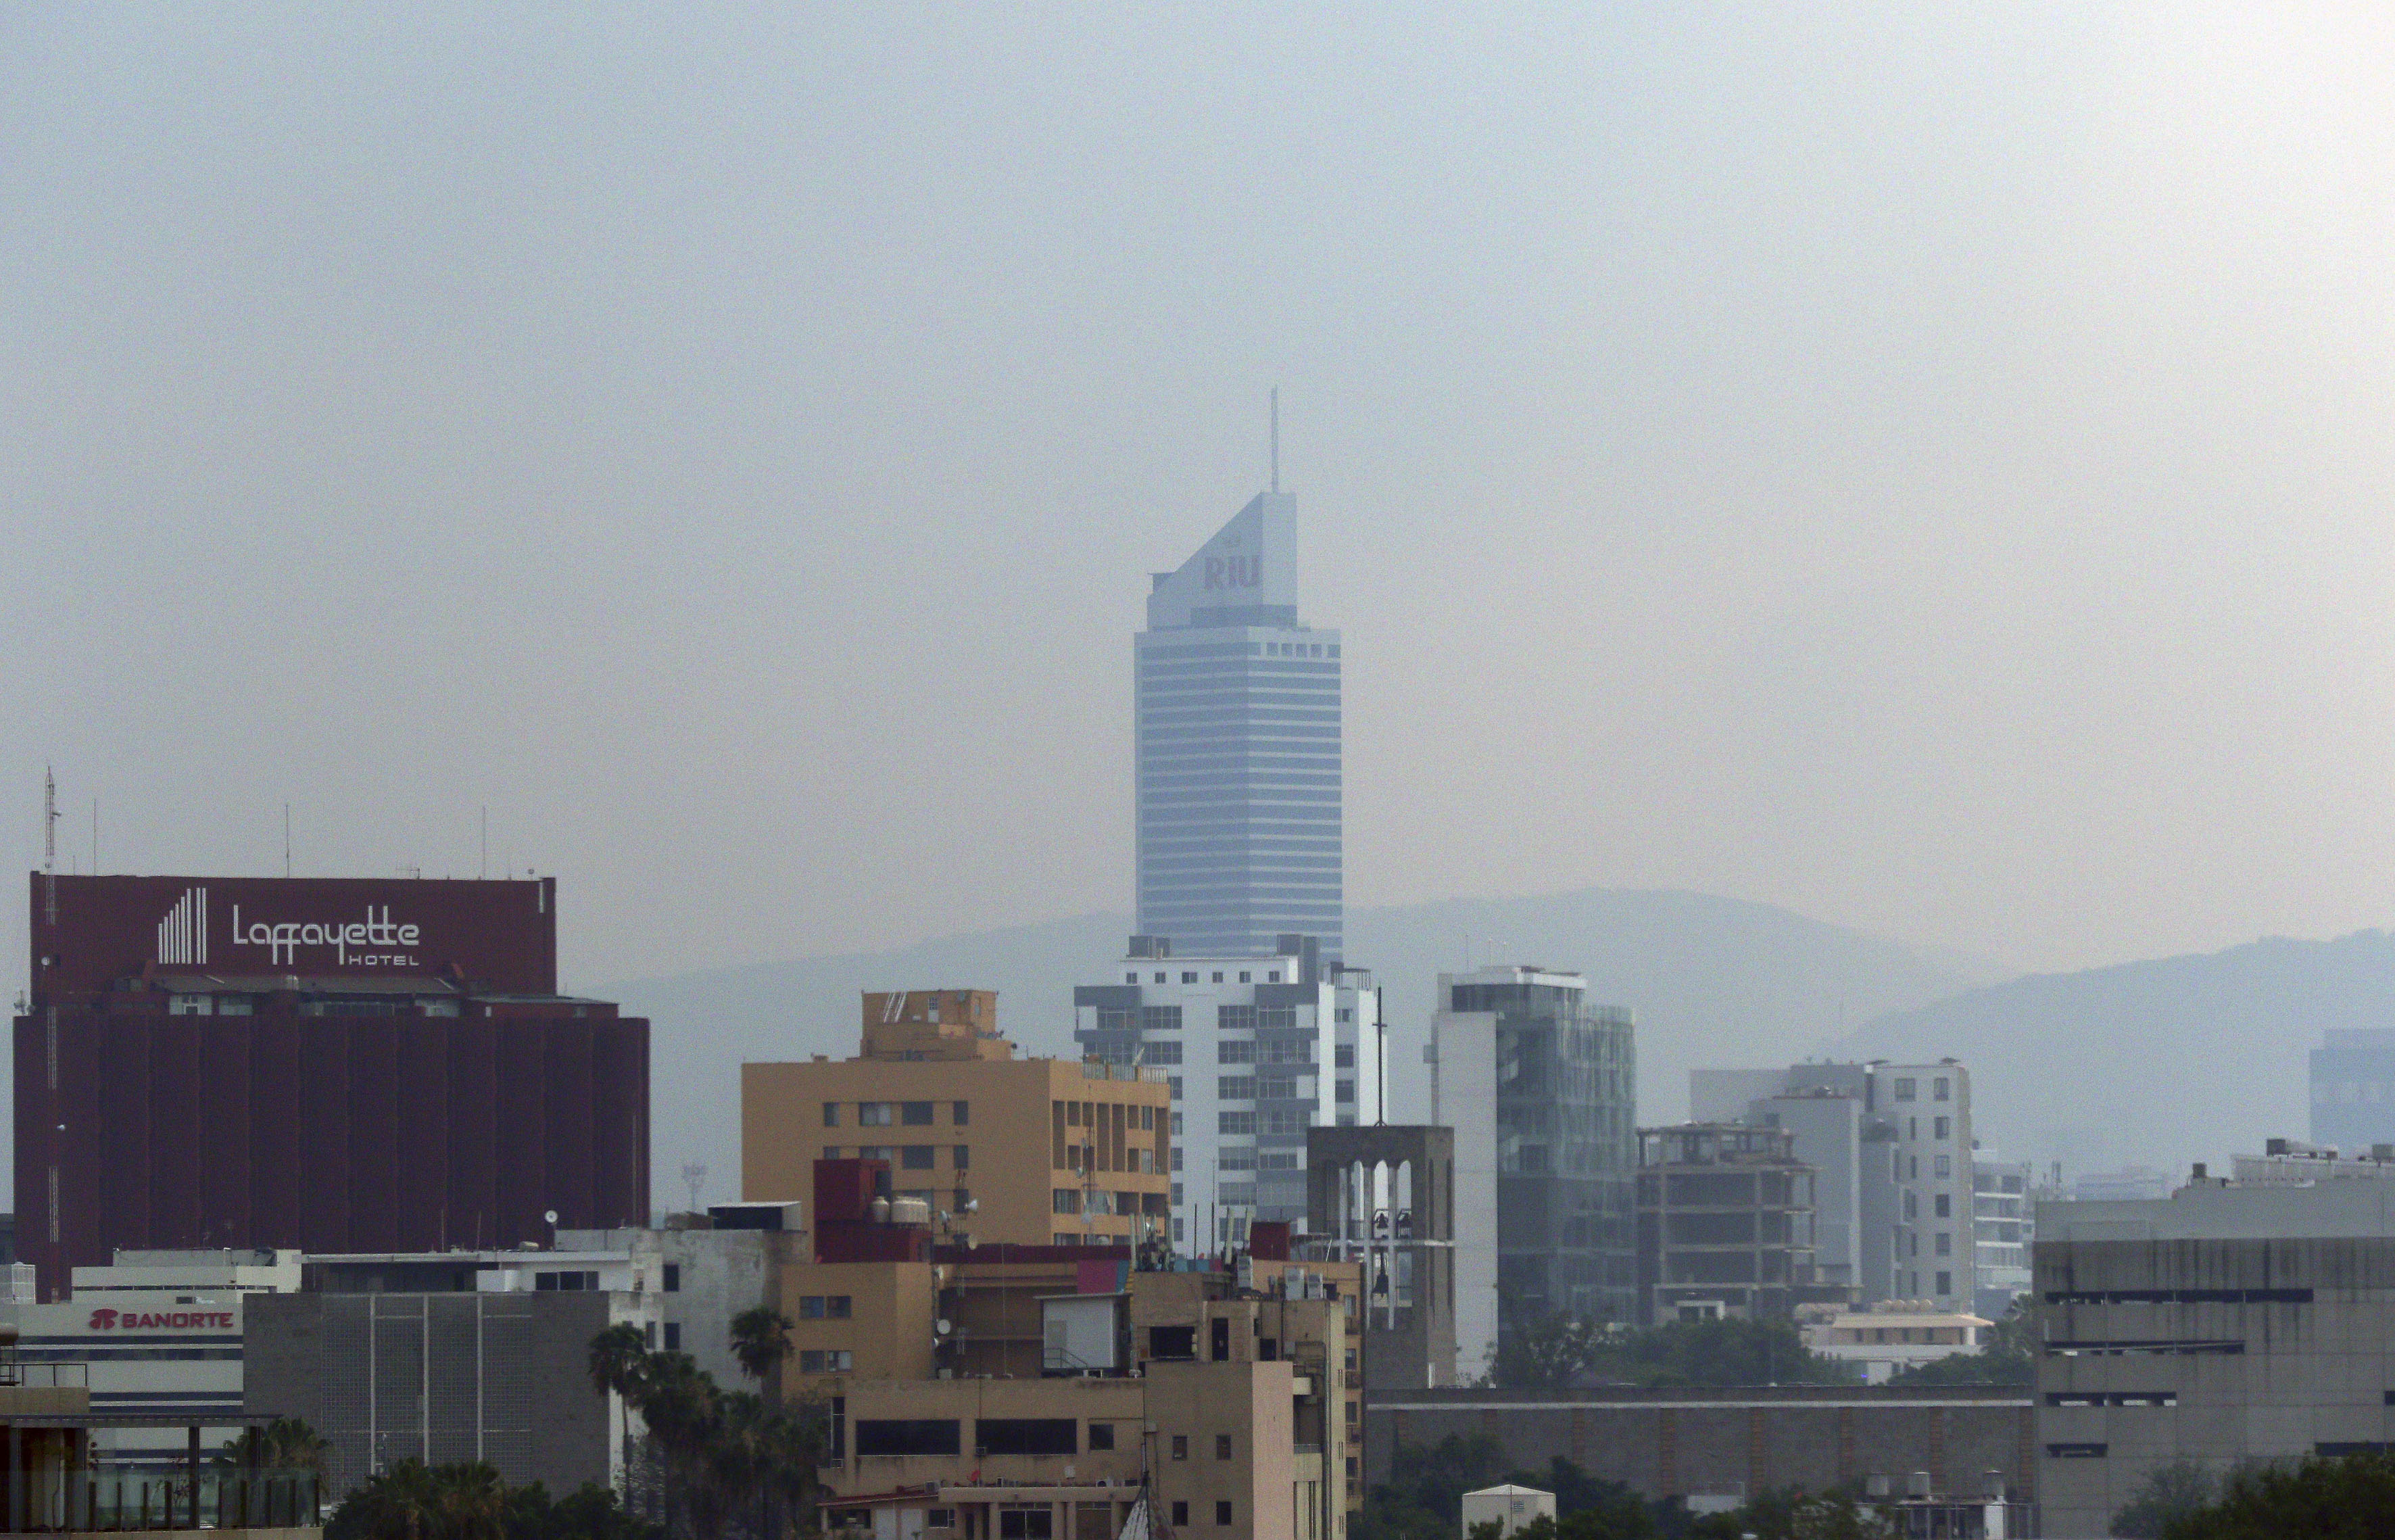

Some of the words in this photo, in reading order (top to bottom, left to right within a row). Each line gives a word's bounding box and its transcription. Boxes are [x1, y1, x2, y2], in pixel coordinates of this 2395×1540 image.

[1205, 555, 1259, 589] RIU
[233, 905, 420, 965] Laffayette
[349, 955, 419, 966] HOTEL
[122, 1312, 233, 1328] BANORTE
